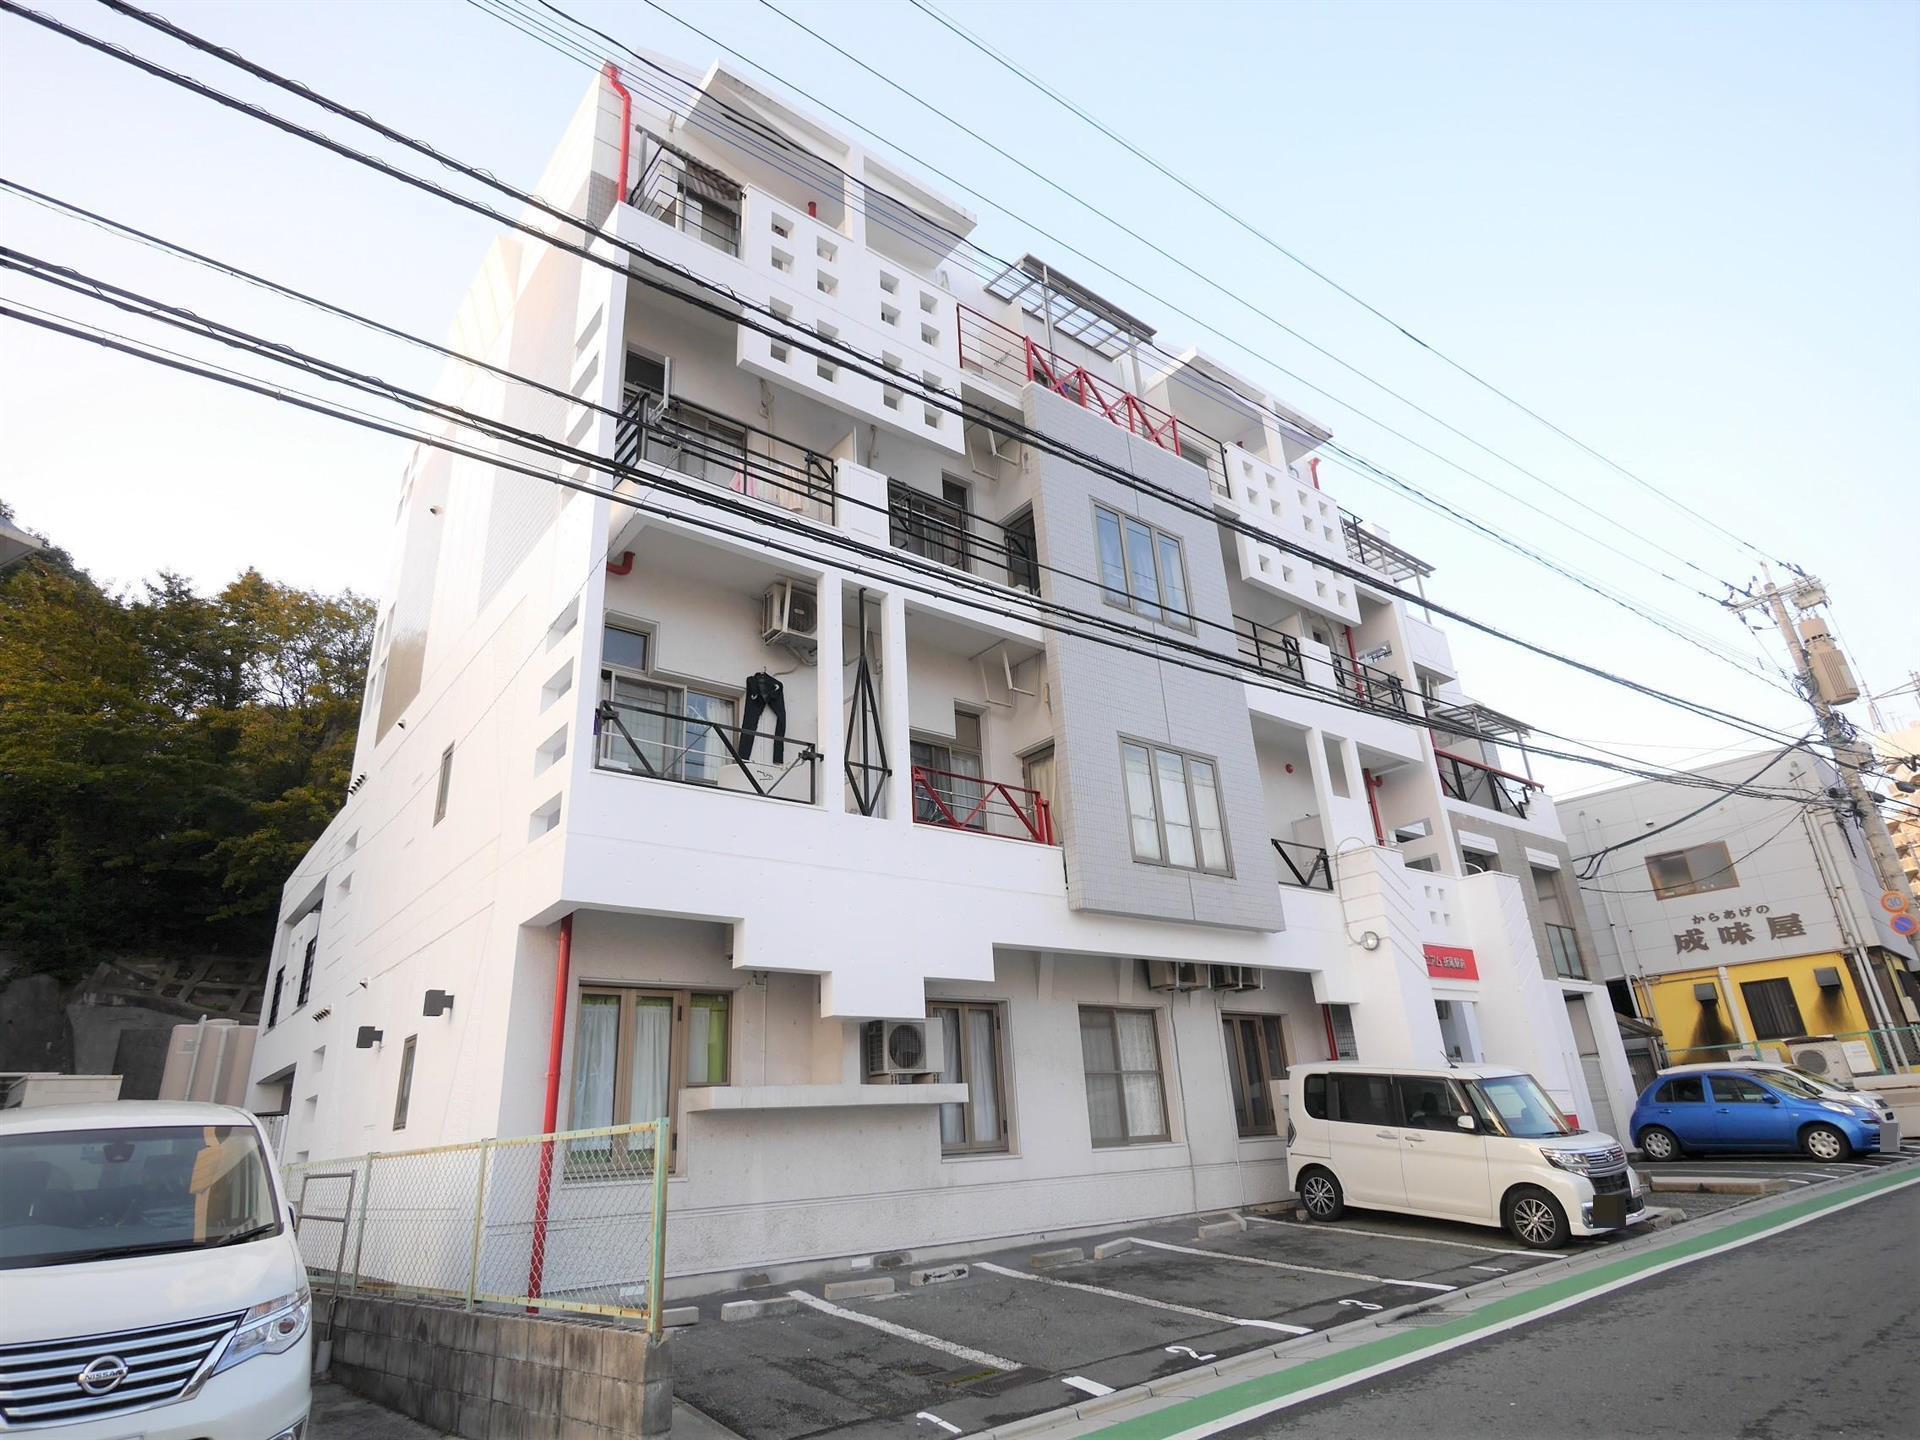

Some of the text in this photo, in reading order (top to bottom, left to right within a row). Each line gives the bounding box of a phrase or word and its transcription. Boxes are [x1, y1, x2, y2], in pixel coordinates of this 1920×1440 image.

[1691, 904, 1770, 925] からあげの
[1337, 1299, 1384, 1311] 3
[1164, 1345, 1217, 1361] 2
[916, 1411, 963, 1434] 1
